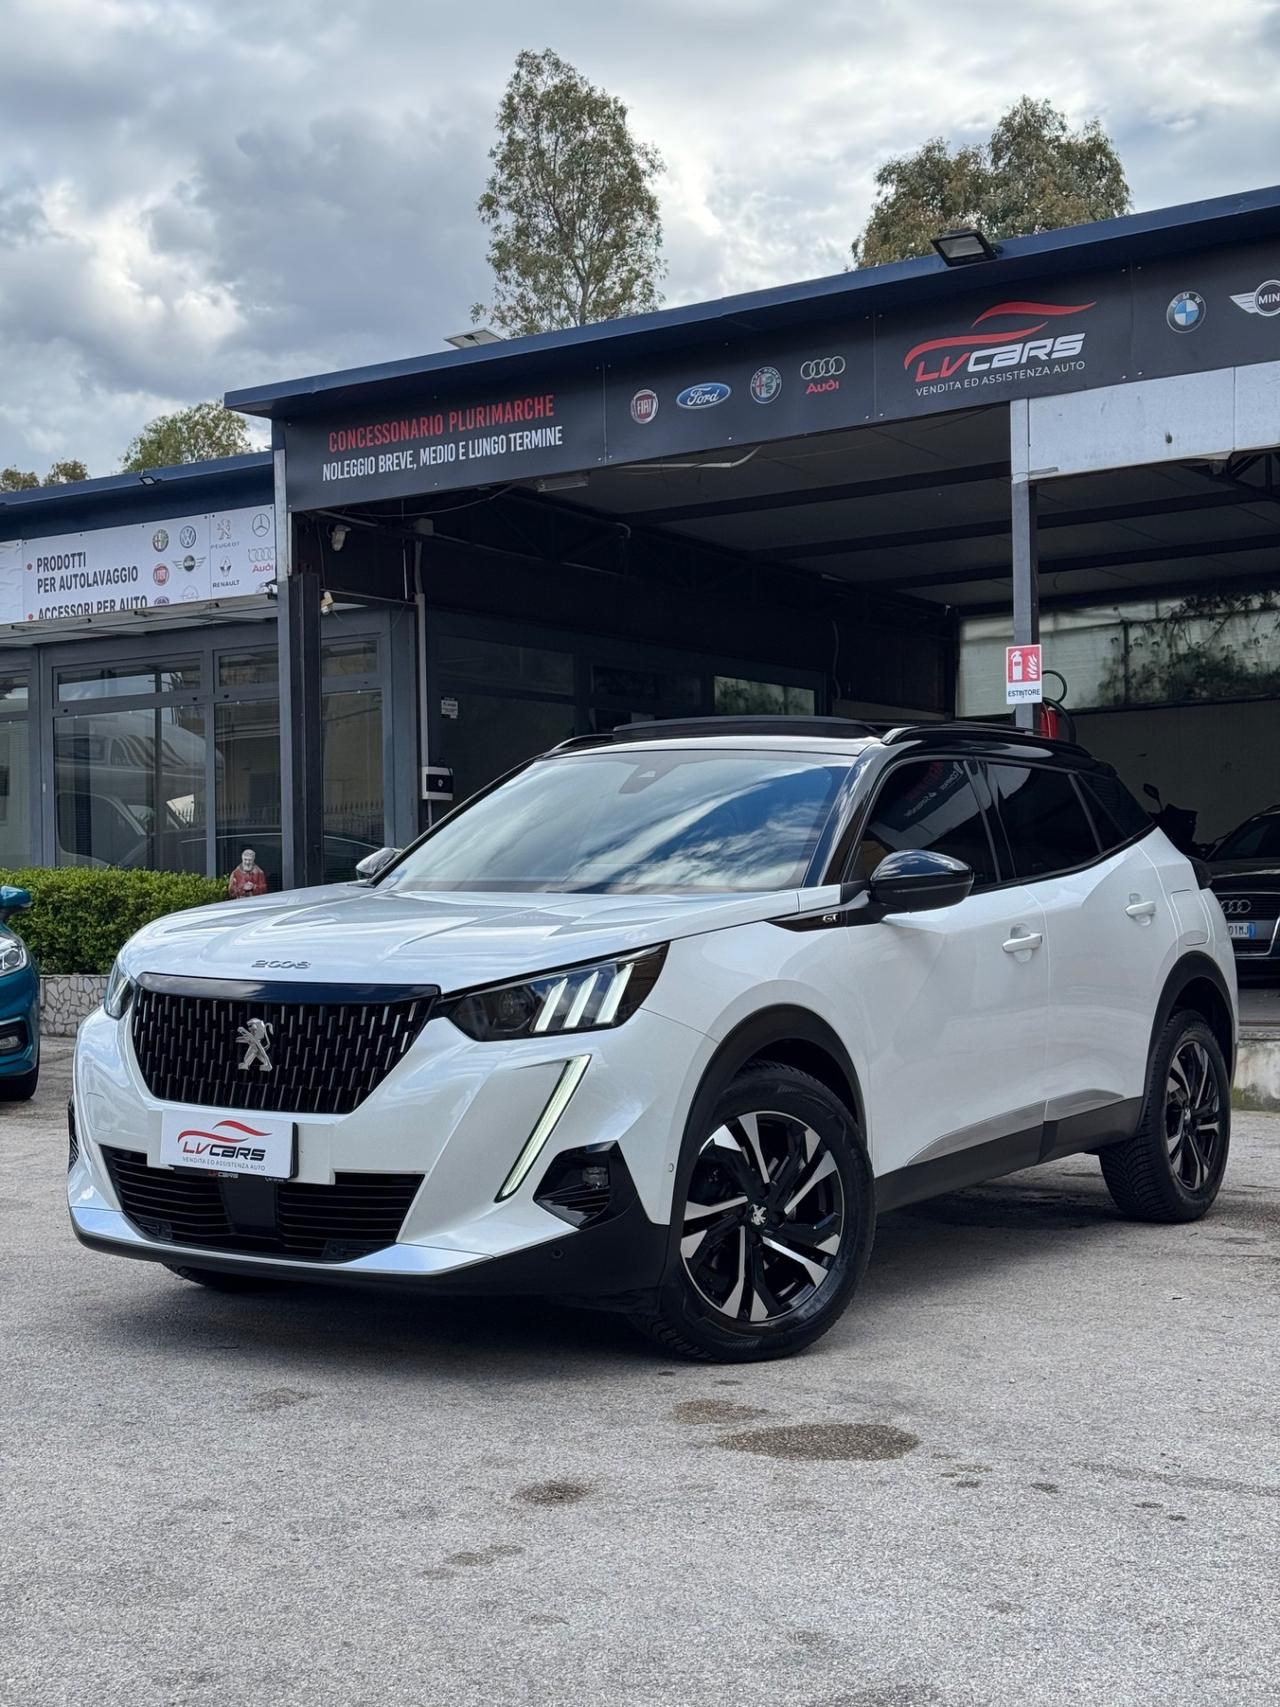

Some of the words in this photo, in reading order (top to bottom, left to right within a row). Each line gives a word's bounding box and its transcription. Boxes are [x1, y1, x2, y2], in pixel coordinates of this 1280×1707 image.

[916, 381, 962, 396] VENDITA
[964, 377, 979, 389] ED
[981, 367, 1051, 385] ASSISTENZA
[1053, 360, 1086, 374] AUTO
[805, 379, 839, 395] Audi
[687, 387, 719, 405] Ford
[636, 399, 652, 415] FIAT
[328, 414, 443, 453] CONCESSONARIO
[449, 395, 554, 432] PLURIMARCHE
[322, 456, 376, 481] NOLEGGIO
[378, 450, 417, 473] BREVE,
[420, 443, 456, 466] MEDIO
[459, 441, 466, 460] E
[469, 435, 507, 458] LUNGO
[508, 426, 563, 452] TERMINE
[36, 552, 87, 573] PRODOTTI
[37, 576, 57, 594] PER
[58, 565, 139, 592] AUTOLAVAGGIO
[212, 579, 240, 588] RENAULT
[1008, 689, 1040, 697] ESTINTORE
[822, 913, 838, 924] GT
[250, 1164, 266, 1172] AUTO
